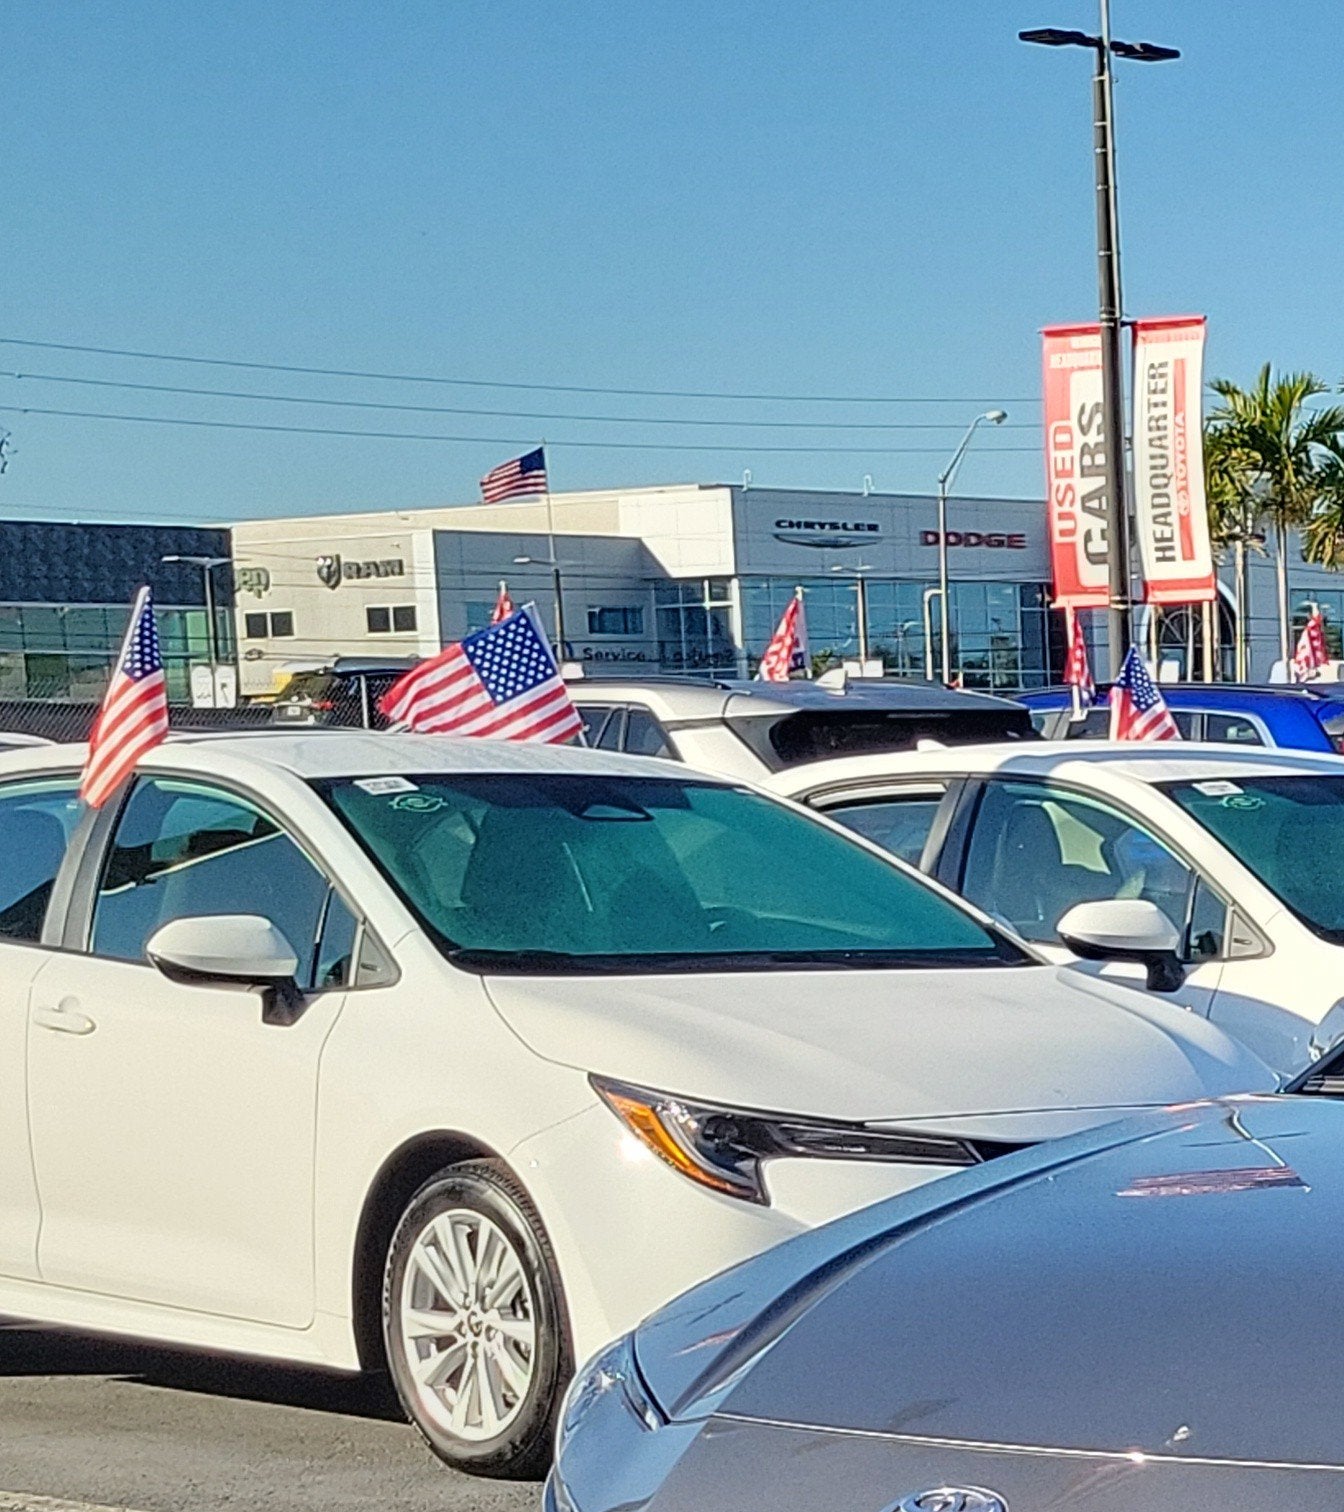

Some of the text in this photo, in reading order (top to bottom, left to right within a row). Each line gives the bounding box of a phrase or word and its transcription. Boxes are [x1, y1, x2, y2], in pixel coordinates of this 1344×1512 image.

[1148, 361, 1176, 563] HEADQUARTER
[1174, 412, 1189, 486] TOYOTA
[1053, 425, 1077, 538] USED
[1077, 402, 1108, 565] CARS
[775, 519, 880, 532] CHRYSLER
[920, 530, 1027, 549] DODGE
[236, 567, 270, 599] ep
[343, 559, 404, 580] RAM
[583, 646, 646, 662] Service
